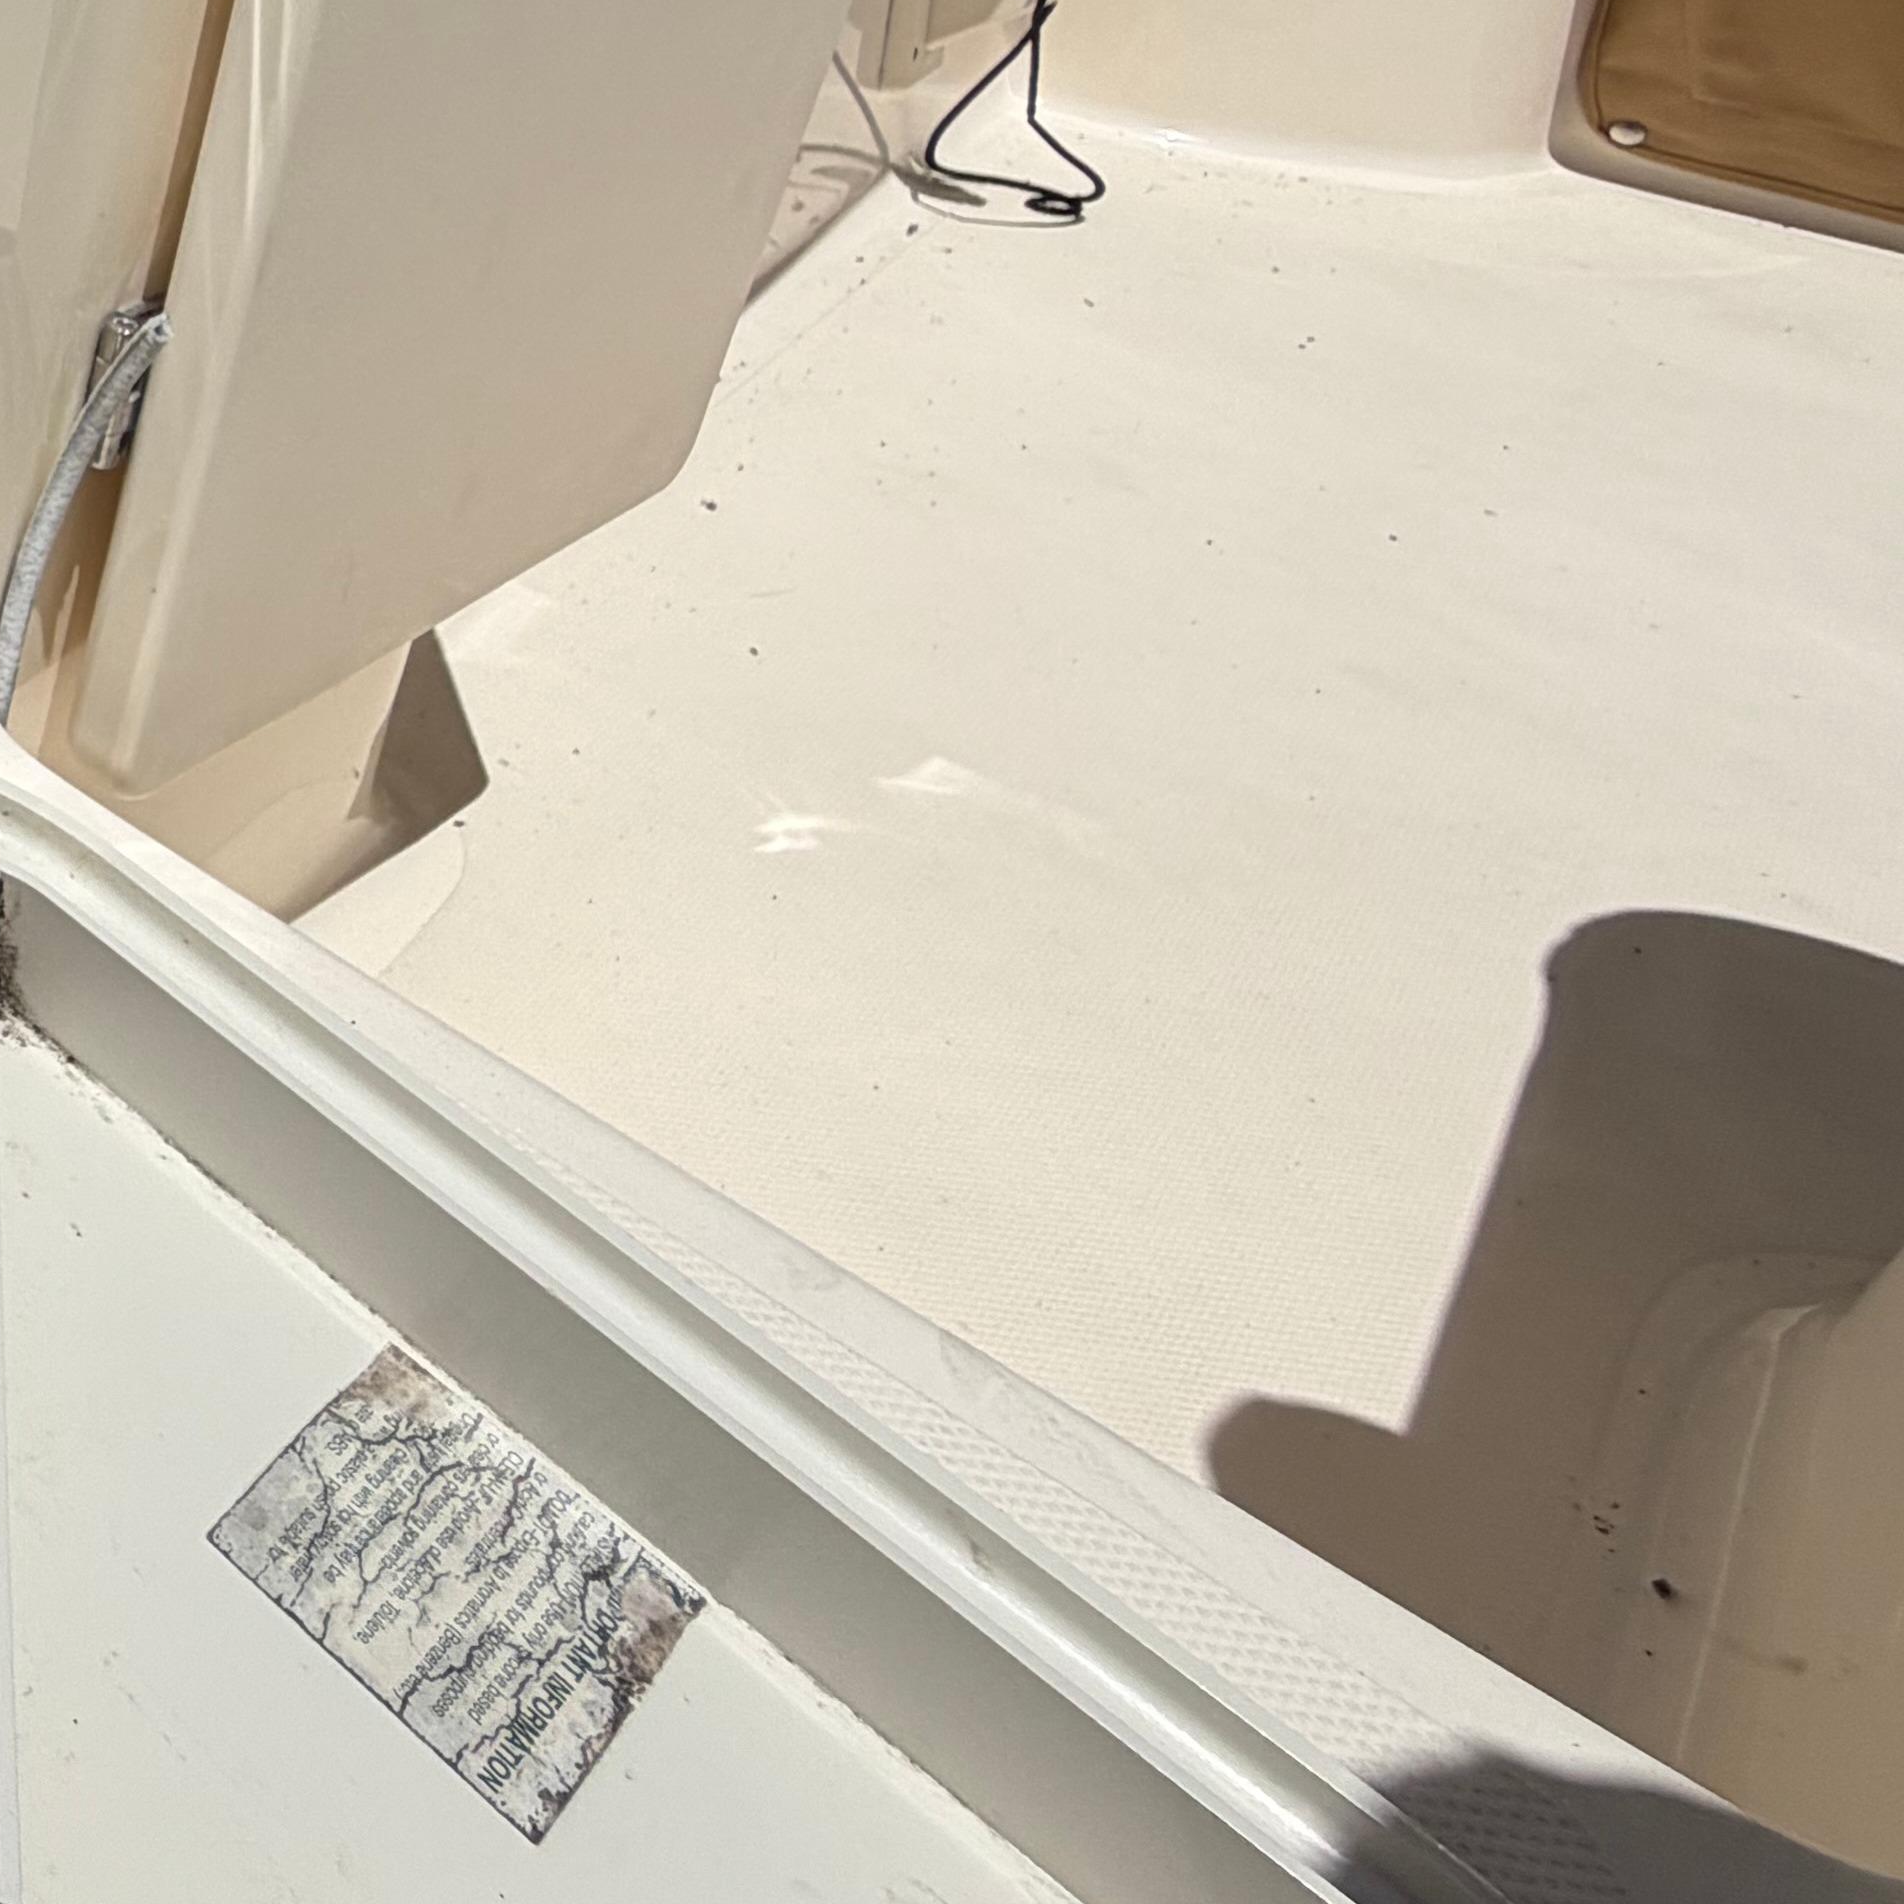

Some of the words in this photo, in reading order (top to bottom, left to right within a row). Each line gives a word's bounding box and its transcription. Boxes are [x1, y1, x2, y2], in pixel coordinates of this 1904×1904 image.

[452, 1574, 503, 1632] Aromatics
[556, 1585, 636, 1684] PORTANT
[465, 1682, 505, 1728] based
[476, 1669, 575, 1795] INFORMATION
